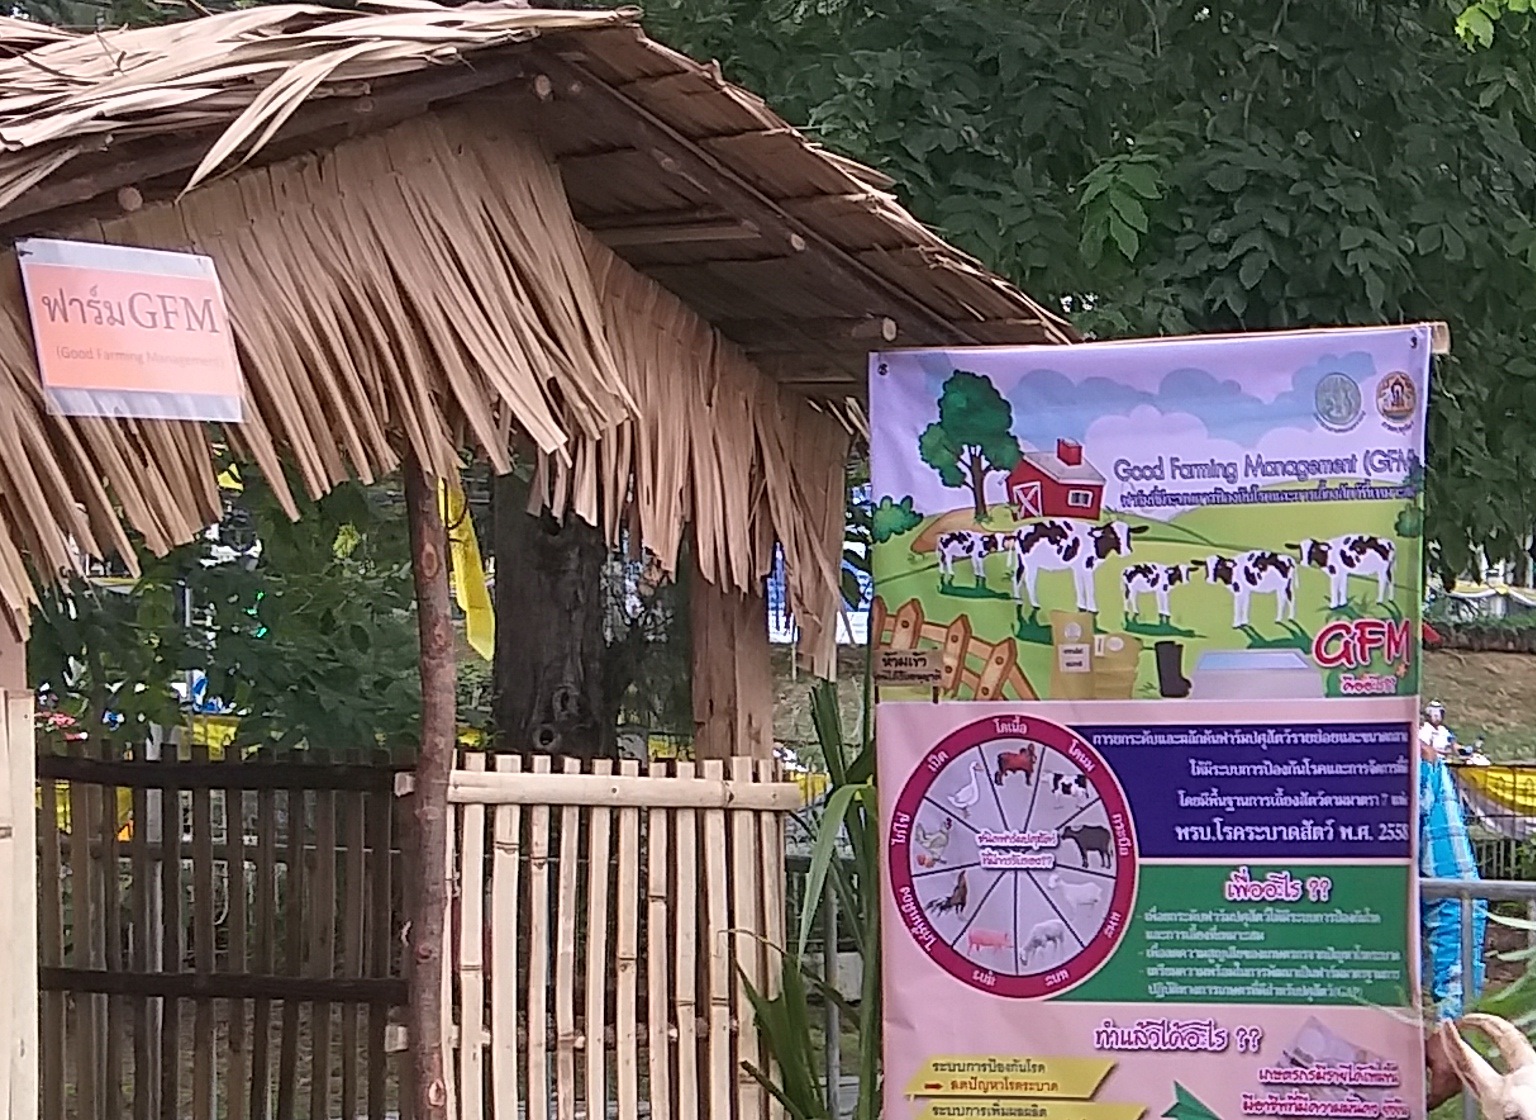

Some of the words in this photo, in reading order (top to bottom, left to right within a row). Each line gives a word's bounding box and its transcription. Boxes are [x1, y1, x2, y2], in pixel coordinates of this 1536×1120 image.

[1114, 457, 1164, 481] Good
[1170, 456, 1238, 483] Farming
[1244, 453, 1357, 481] Management
[1313, 618, 1410, 667] GFM
[882, 651, 927, 667] ห้ามเข้า
[994, 719, 1027, 734] โคเนื้อ
[928, 750, 949, 774] เป็ด
[1068, 739, 1095, 772] โคนม
[1175, 818, 1335, 842] พรบ.โรคระบาดสัตว์
[1340, 825, 1374, 841] พ.ศ.
[1225, 867, 1301, 900] เพื่ออะไร
[1094, 1017, 1228, 1051] ทำแล้วได้อะไร
[932, 1058, 1046, 1073] ระบบการป้องกันโรค
[950, 1077, 1058, 1094] ลดปัญหาโรคระบาด
